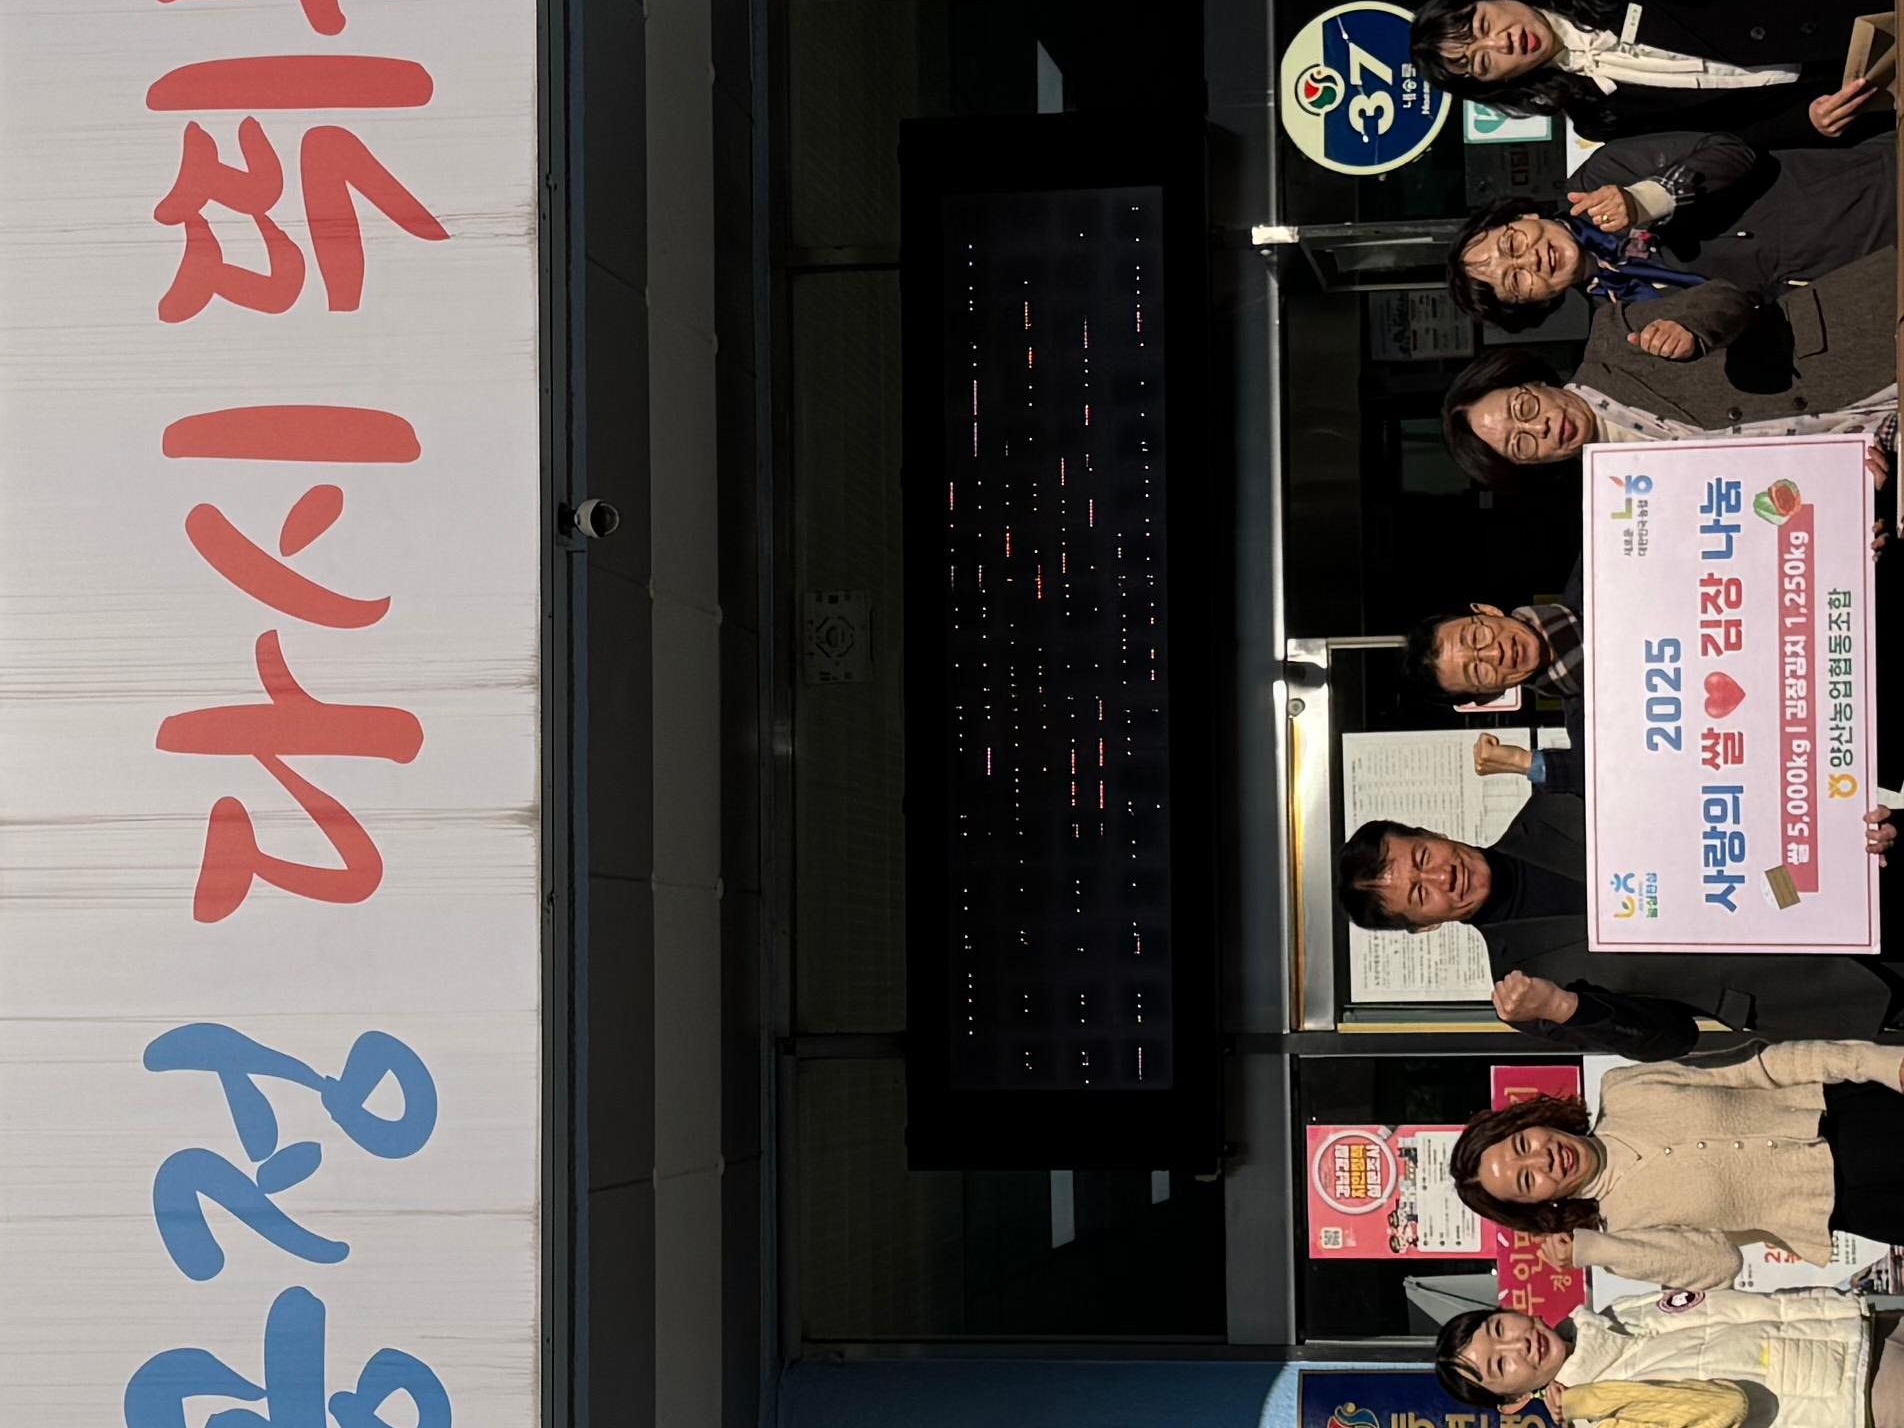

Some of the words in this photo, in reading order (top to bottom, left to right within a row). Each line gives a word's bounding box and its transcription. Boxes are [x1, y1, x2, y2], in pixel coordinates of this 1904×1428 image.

[1349, 41, 1394, 135] 37
[1699, 477, 1742, 560] 나눔
[1699, 573, 1743, 658] 김장
[1784, 531, 1809, 628] 1,250kg
[149, 408, 425, 924] 다시
[1645, 637, 1682, 752] 2025
[1784, 636, 1808, 719] 김장김치
[1828, 588, 1853, 768] 양산농업협동조합
[1701, 728, 1744, 771] 쌀
[1787, 739, 1811, 837] 5,000kg
[1702, 785, 1745, 912] 사랑의
[1788, 843, 1810, 864] 쌀
